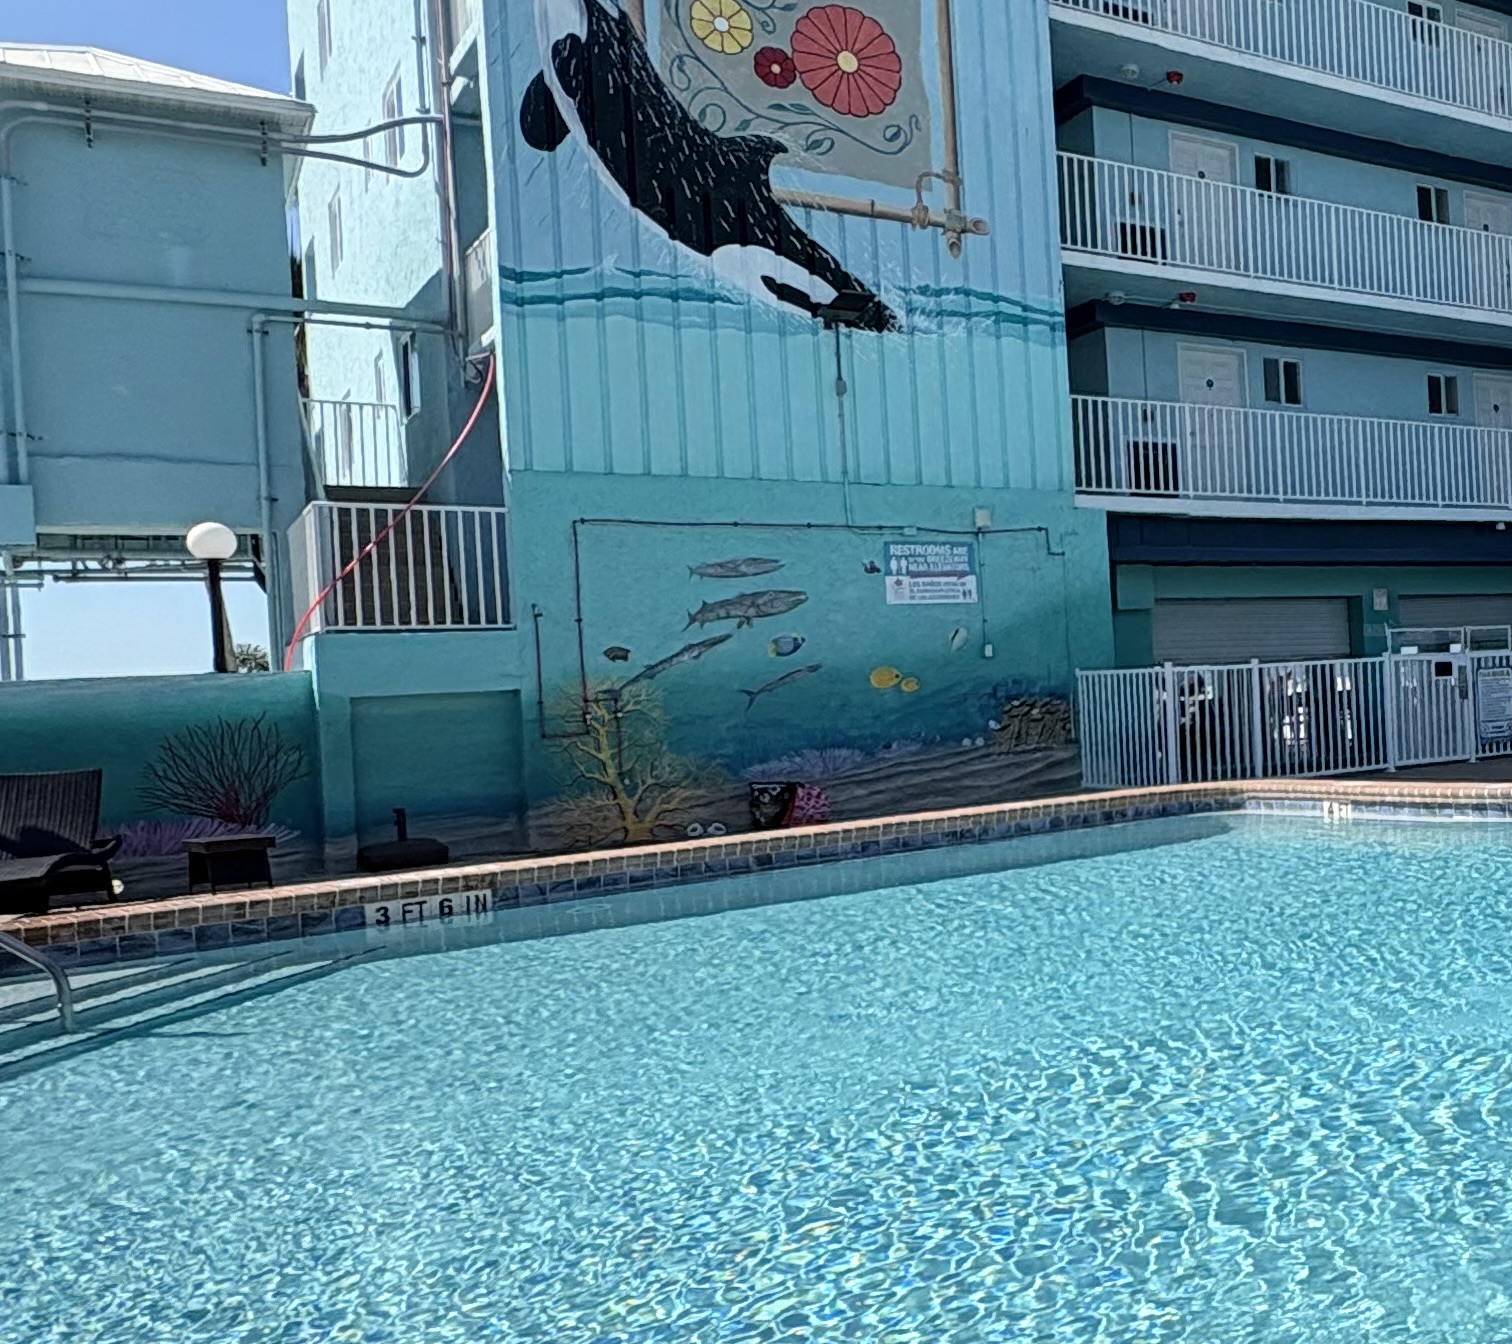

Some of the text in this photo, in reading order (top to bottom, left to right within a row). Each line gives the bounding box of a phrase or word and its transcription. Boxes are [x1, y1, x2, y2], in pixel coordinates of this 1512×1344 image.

[889, 544, 951, 556] RESTROOMS
[375, 893, 489, 926] 3 FT 6 IN
